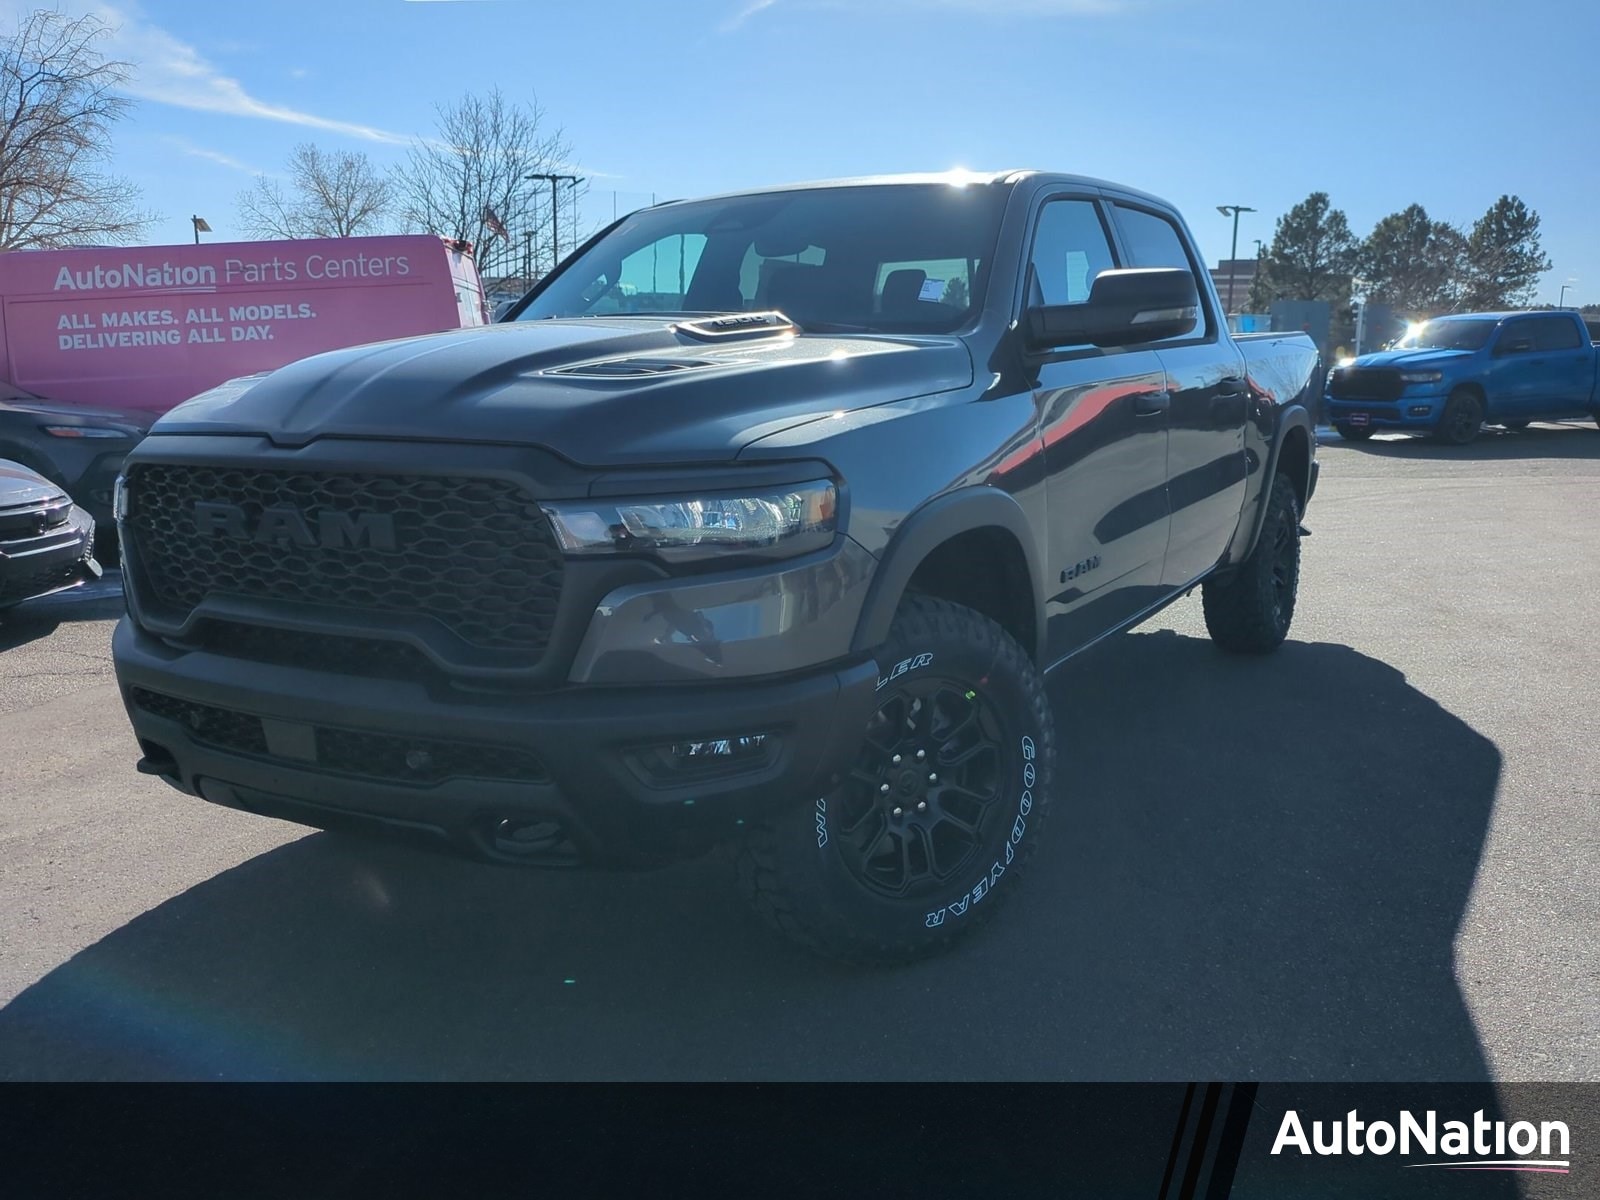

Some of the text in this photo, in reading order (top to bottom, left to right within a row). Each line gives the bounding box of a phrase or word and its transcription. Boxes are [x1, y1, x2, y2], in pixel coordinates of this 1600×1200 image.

[54, 252, 410, 291] AutoNation Parts Centers
[57, 303, 317, 330] ALL MAKES. ALL MODELS.
[59, 325, 274, 350] DELIVERING ALL DAY.
[194, 501, 397, 550] RAM
[1060, 555, 1101, 583] RAM
[925, 735, 1036, 928] GOODYEAR
